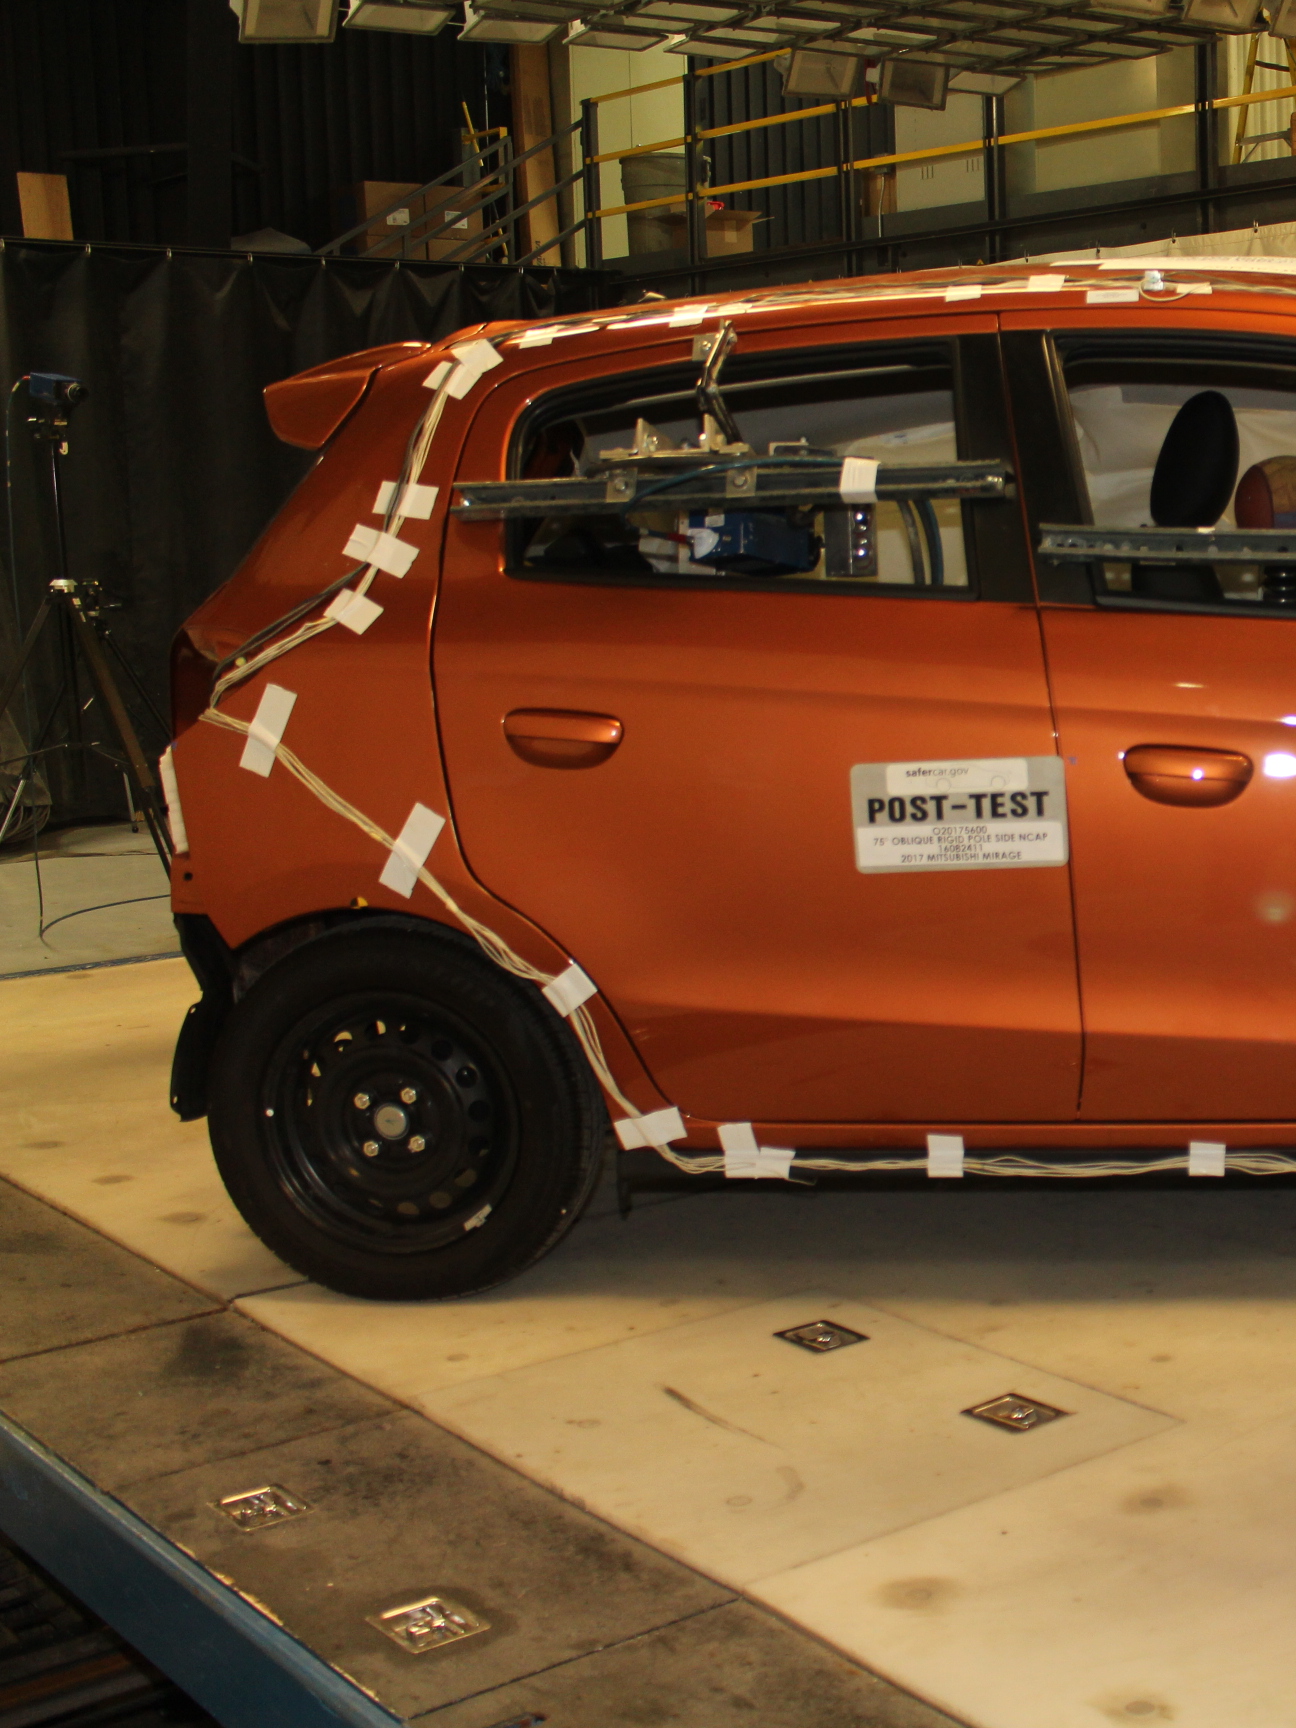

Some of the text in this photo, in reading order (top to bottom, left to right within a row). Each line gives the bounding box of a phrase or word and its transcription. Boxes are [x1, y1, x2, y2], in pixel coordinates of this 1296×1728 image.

[905, 767, 970, 778] safercar.gov
[867, 791, 1050, 824] POST-TEST
[891, 836, 935, 846] OBLIQUE
[937, 835, 965, 845] RIGID
[968, 834, 992, 844] POLE
[995, 833, 1016, 843] SIDE
[1018, 832, 1048, 842] NCAP
[938, 844, 983, 854] 16082411
[901, 851, 1023, 864] 2017 MITSUBISHI MIRAGE
